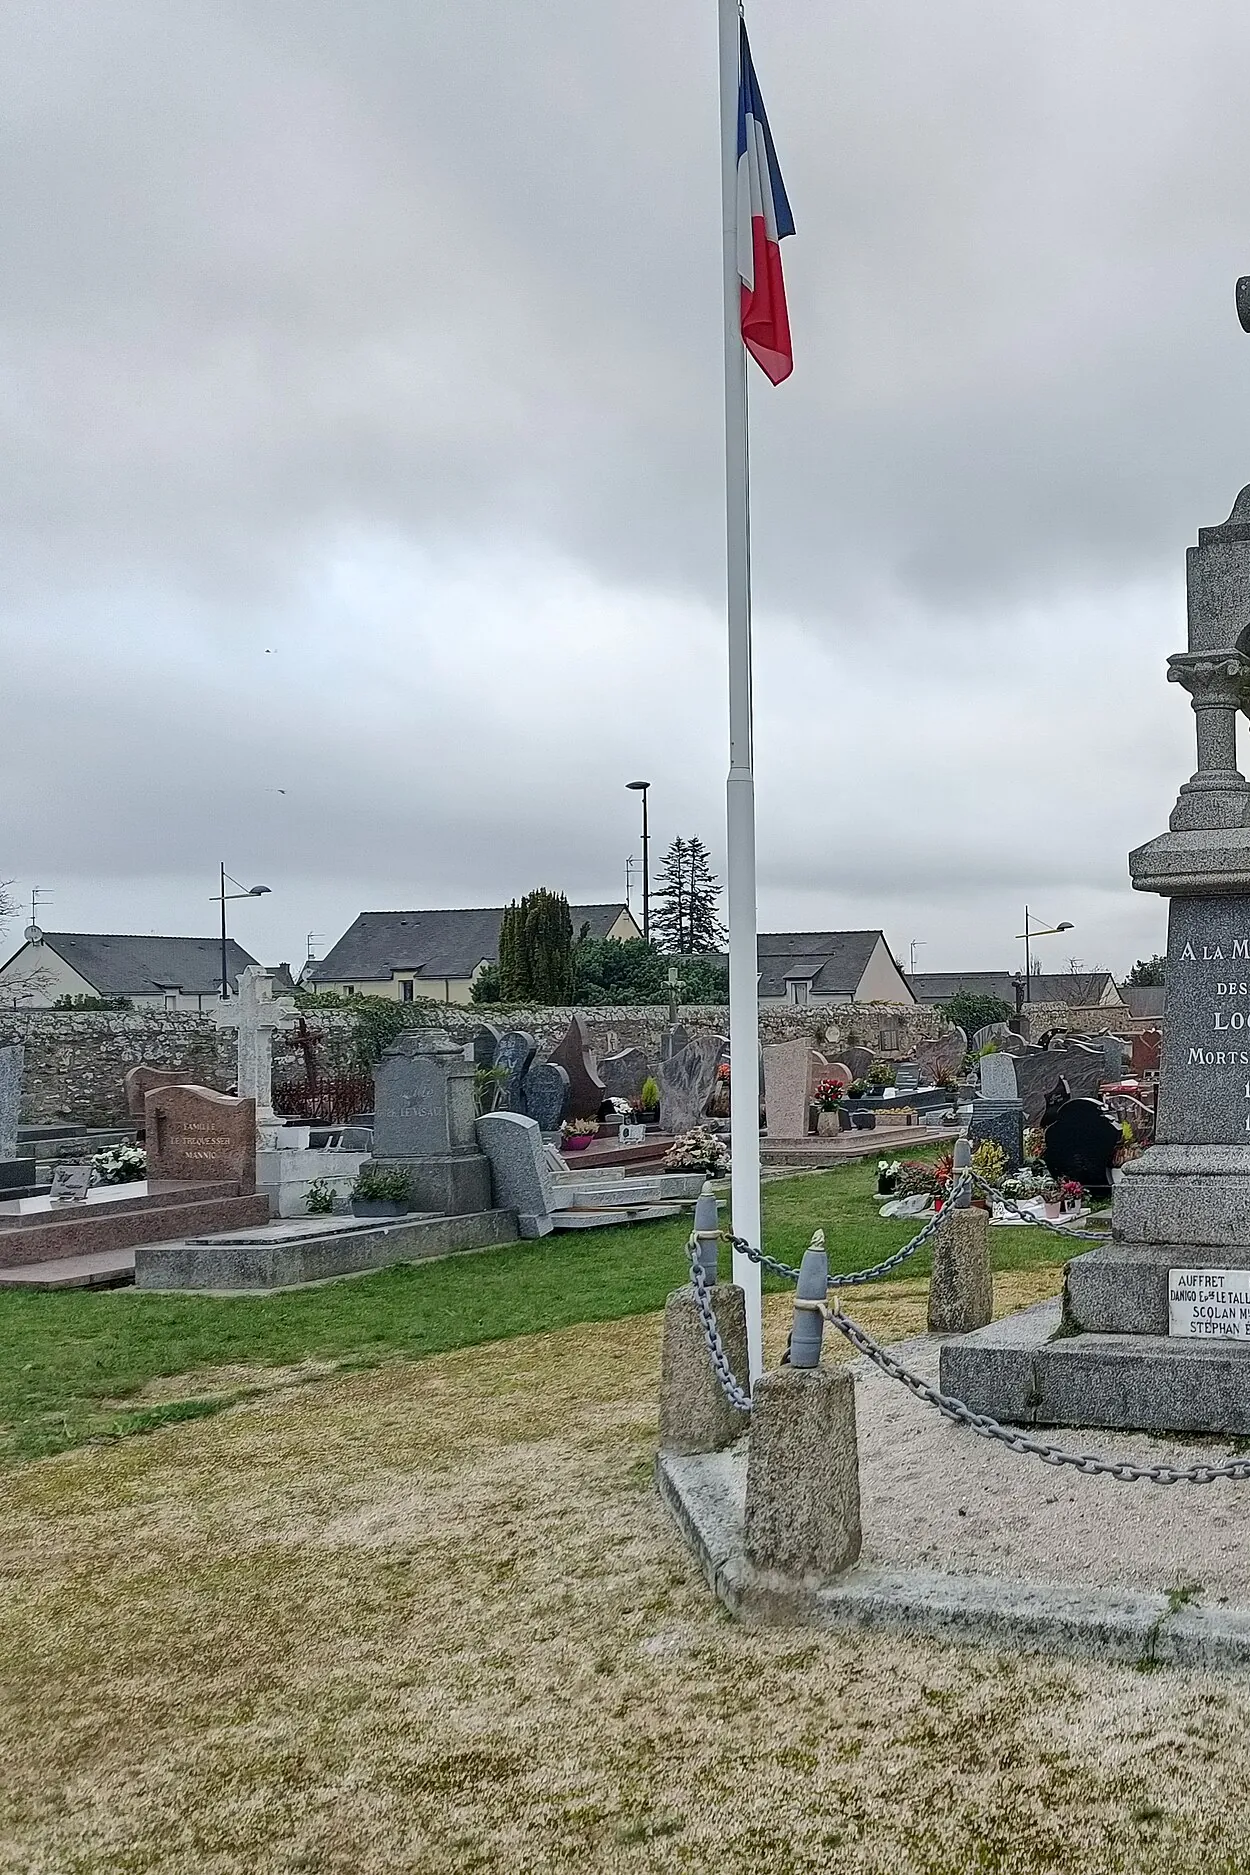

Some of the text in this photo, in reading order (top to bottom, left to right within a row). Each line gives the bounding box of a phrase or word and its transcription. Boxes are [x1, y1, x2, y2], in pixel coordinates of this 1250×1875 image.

[1180, 943, 1196, 961] A
[1203, 943, 1224, 960] LA
[1216, 982, 1248, 996] DES
[1187, 1048, 1249, 1065] MORTS
[1178, 1275, 1225, 1287] AUFFRET
[1170, 1290, 1197, 1302] DANIGO
[1216, 1291, 1226, 1304] LE
[1193, 1306, 1236, 1319] SCOLAN
